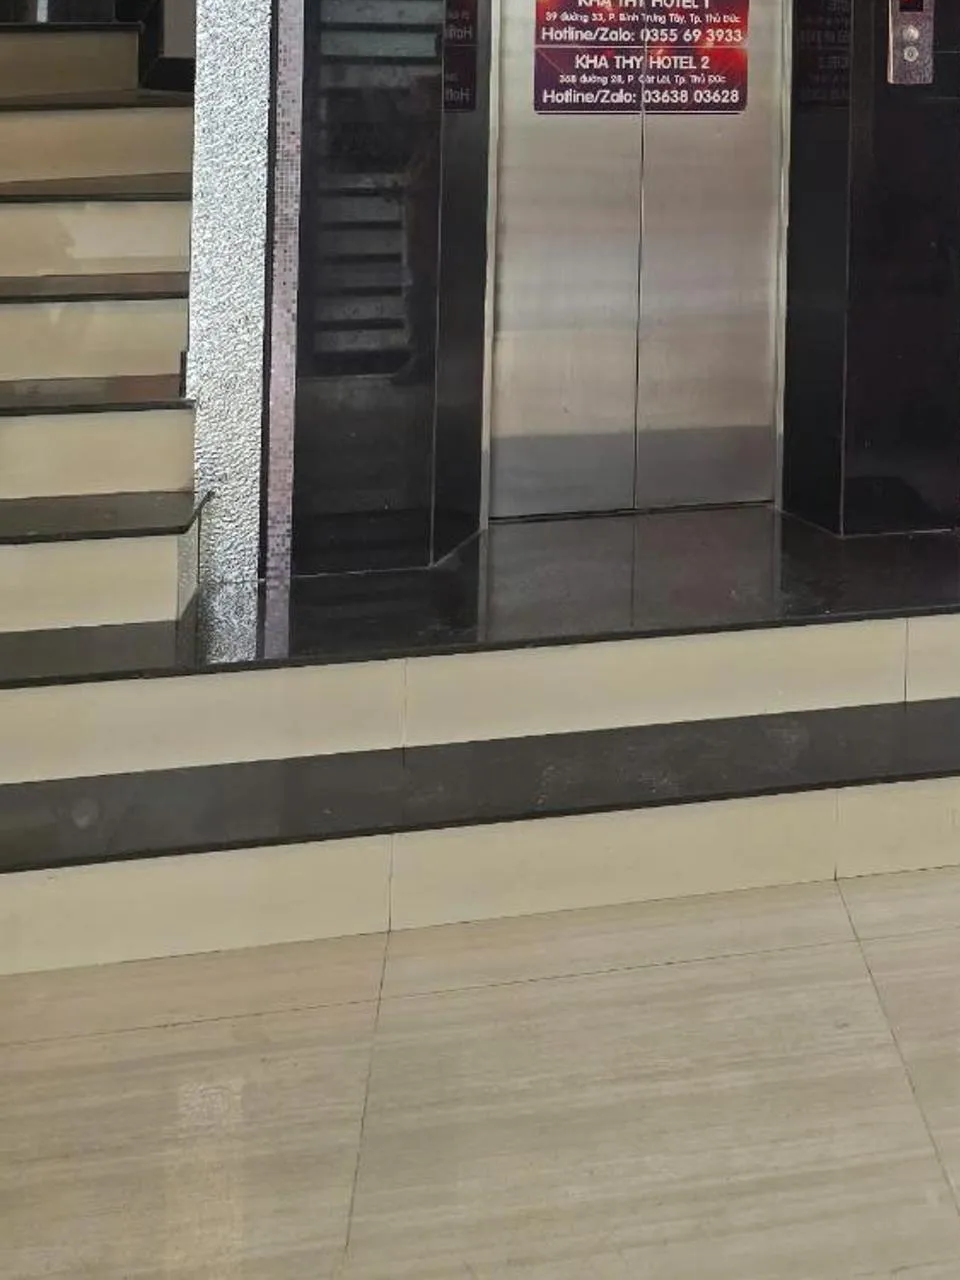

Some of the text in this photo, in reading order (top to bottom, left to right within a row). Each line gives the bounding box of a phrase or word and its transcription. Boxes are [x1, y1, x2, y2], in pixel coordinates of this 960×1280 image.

[541, 27, 743, 42] Hotline/Zalo: 0355 69 3933
[575, 55, 710, 70] KHA THY HOTEL 2
[542, 90, 740, 104] Hotline/Zalo: 03638 03628
